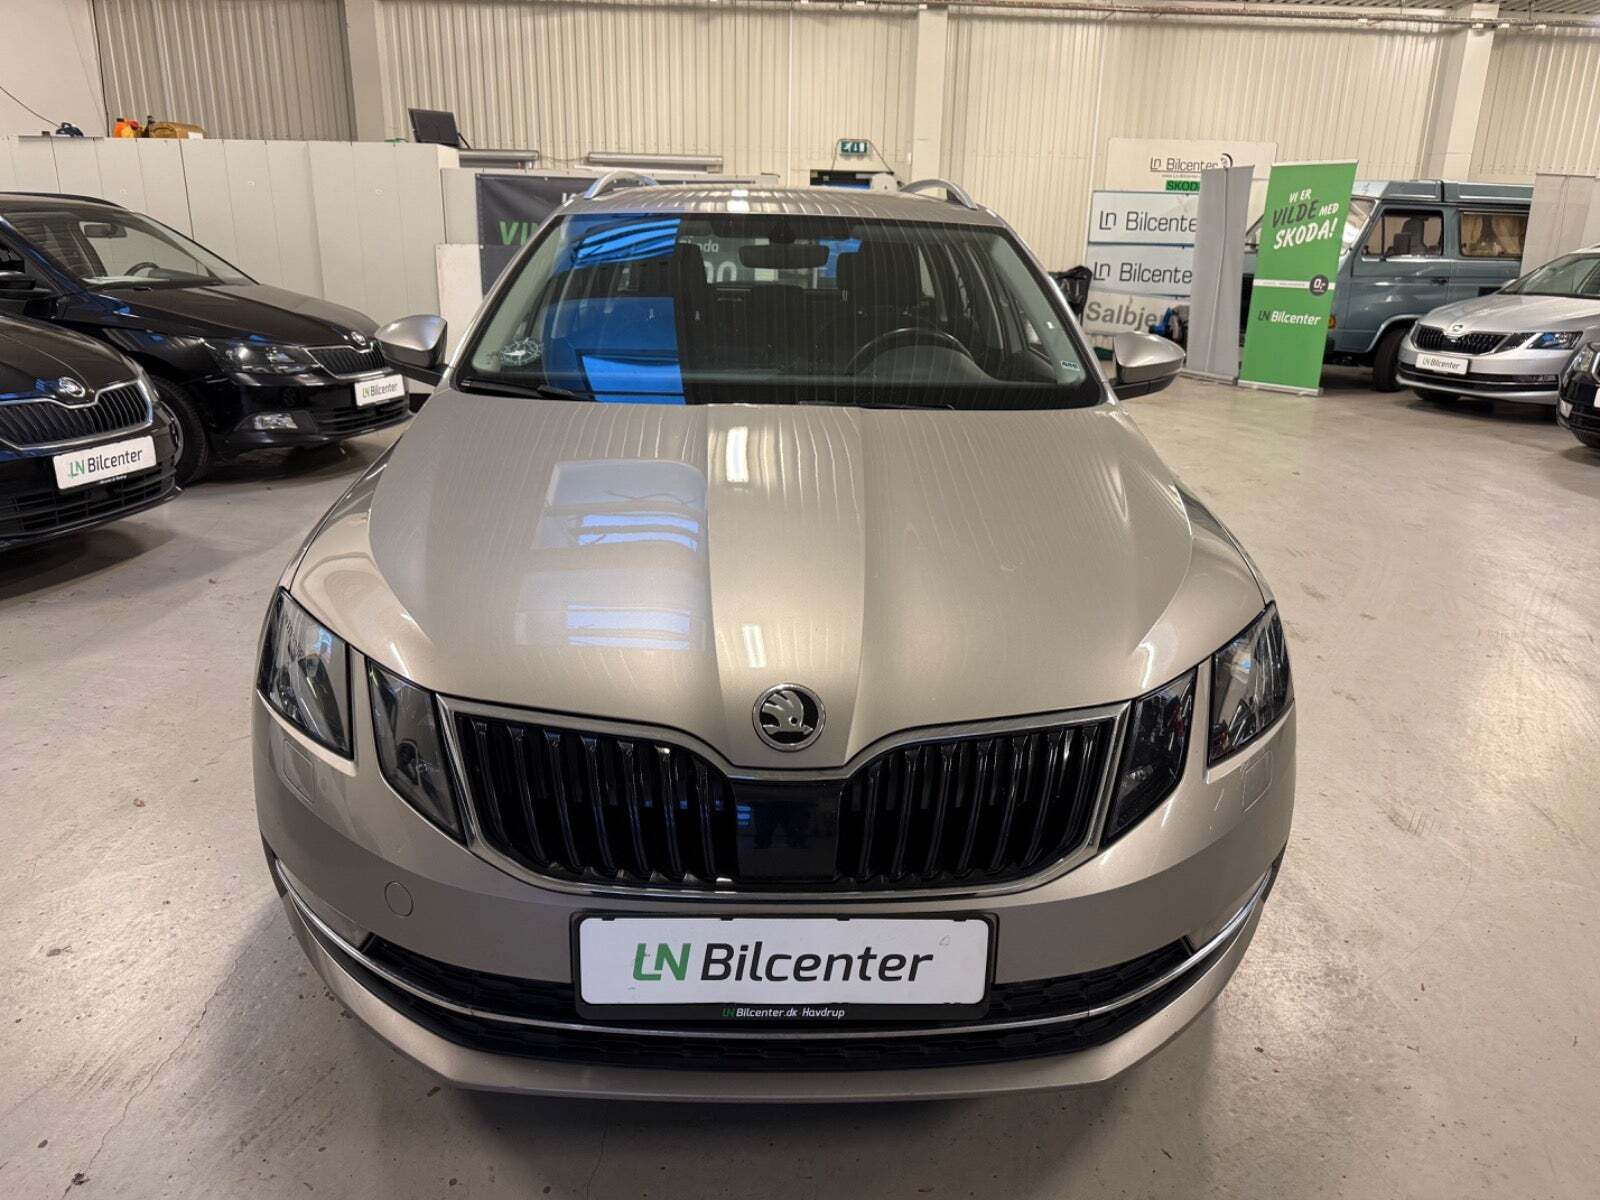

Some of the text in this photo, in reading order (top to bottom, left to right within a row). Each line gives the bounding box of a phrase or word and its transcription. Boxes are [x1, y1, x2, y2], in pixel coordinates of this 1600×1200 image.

[1165, 180, 1200, 191] SKOD
[1300, 188, 1312, 200] ER
[1125, 211, 1197, 232] Bilcente
[1272, 199, 1340, 228] VILDE MED
[1273, 217, 1338, 250] SKODA!
[1119, 262, 1193, 284] Bilcente
[1085, 301, 1158, 333] Salbje
[87, 449, 143, 473] Bilcenter
[700, 941, 934, 983] Bilcenter
[802, 1007, 845, 1020] Havdrup
